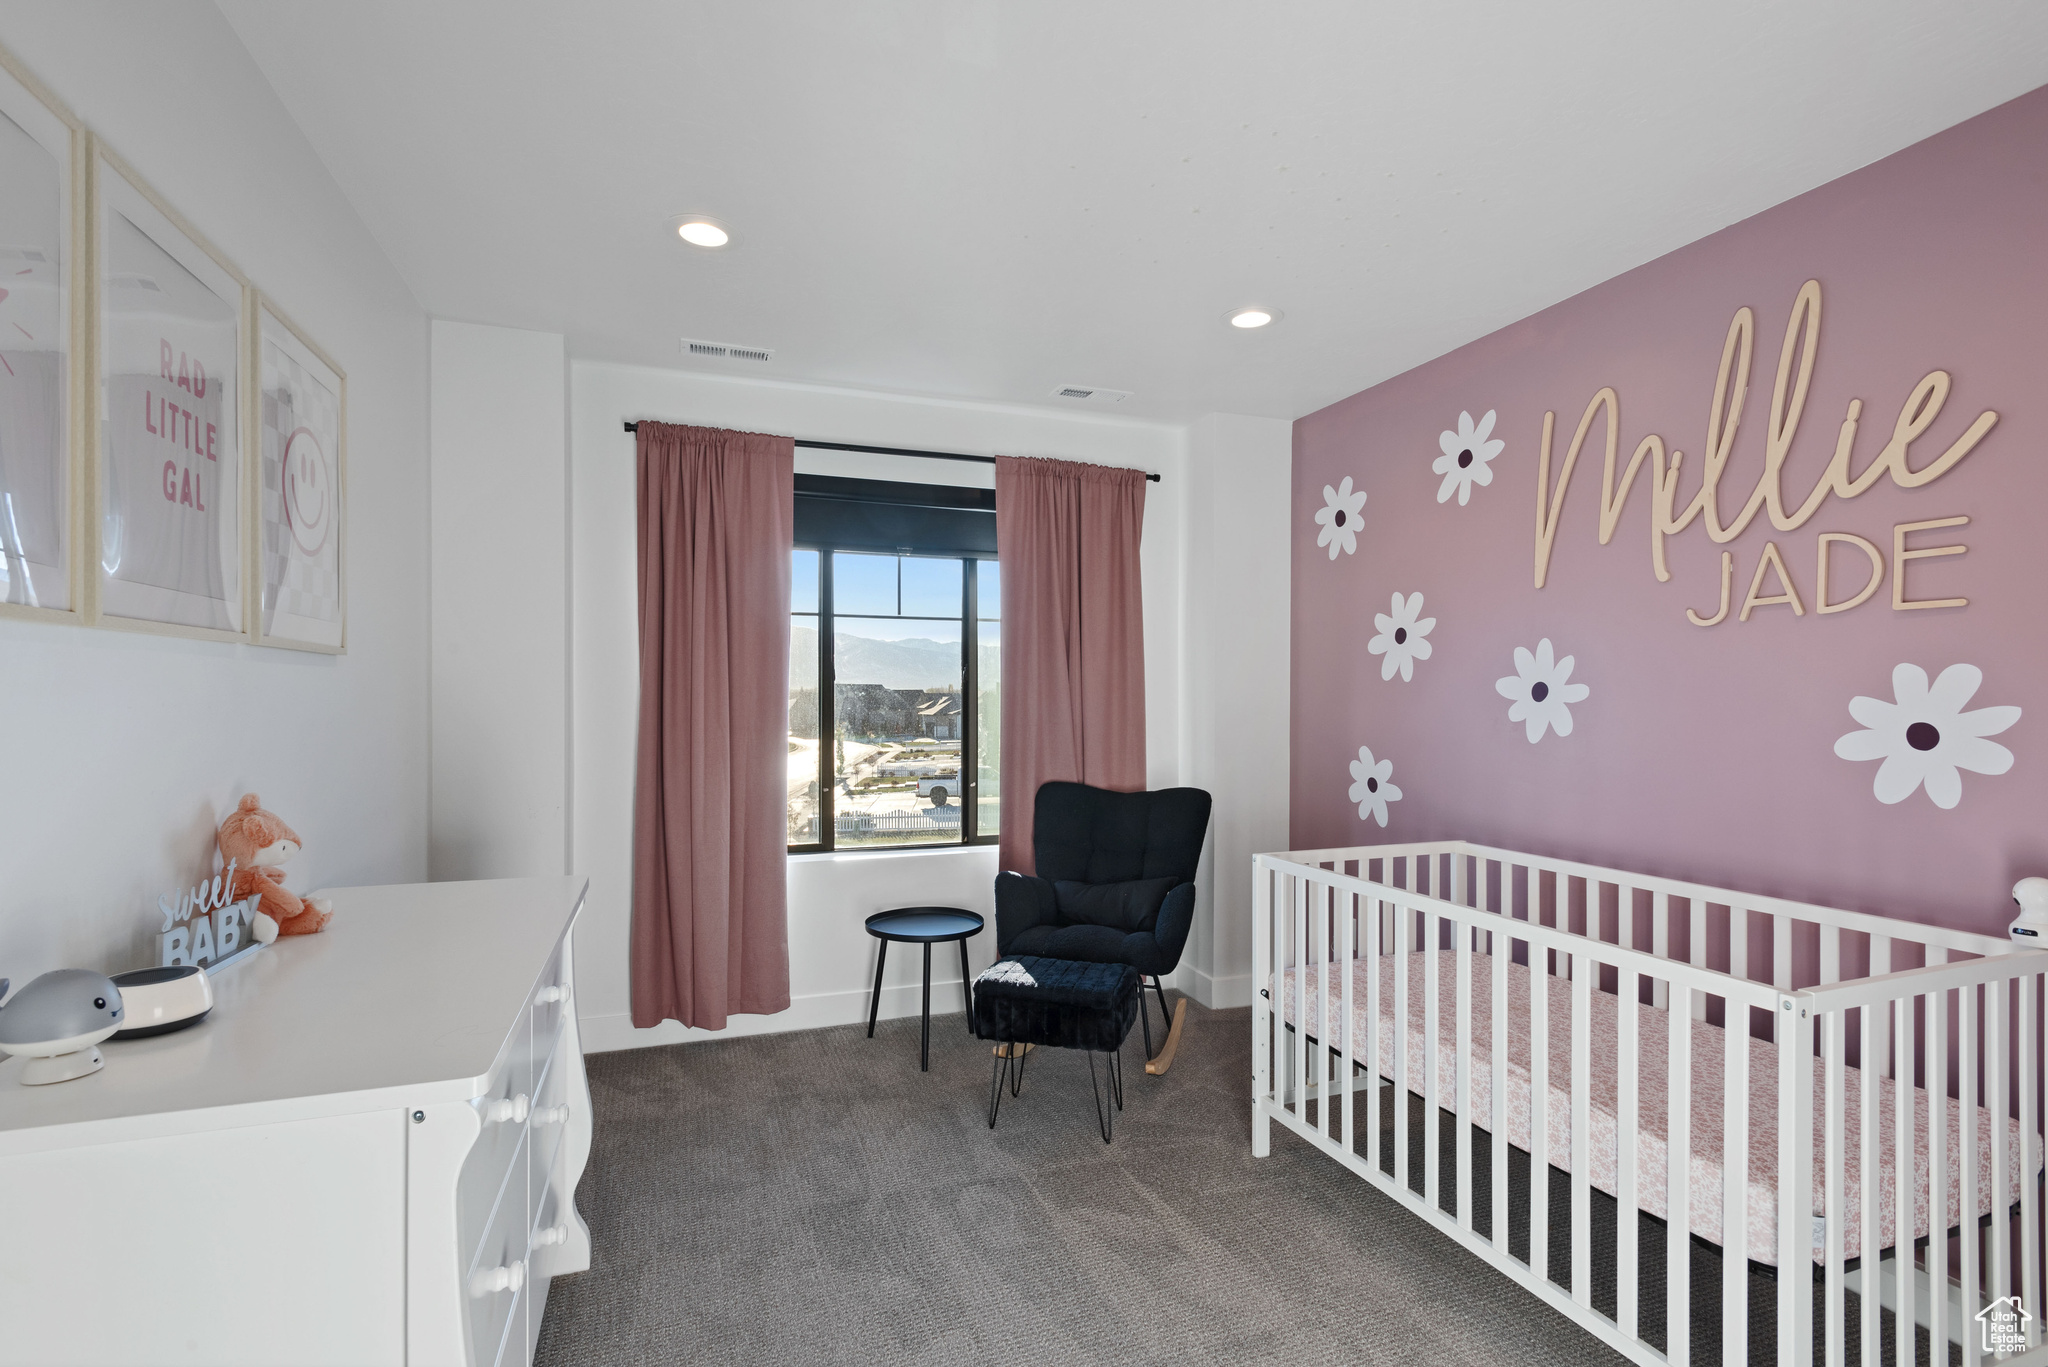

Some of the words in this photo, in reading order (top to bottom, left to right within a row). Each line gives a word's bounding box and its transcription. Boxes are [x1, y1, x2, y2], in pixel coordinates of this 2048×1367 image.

[160, 337, 206, 399] RAD
[146, 390, 217, 462] LITTLE
[1534, 279, 1998, 589] Millie
[163, 459, 205, 512] GAL
[1686, 516, 1970, 627] JADE
[162, 893, 262, 967] BABY
